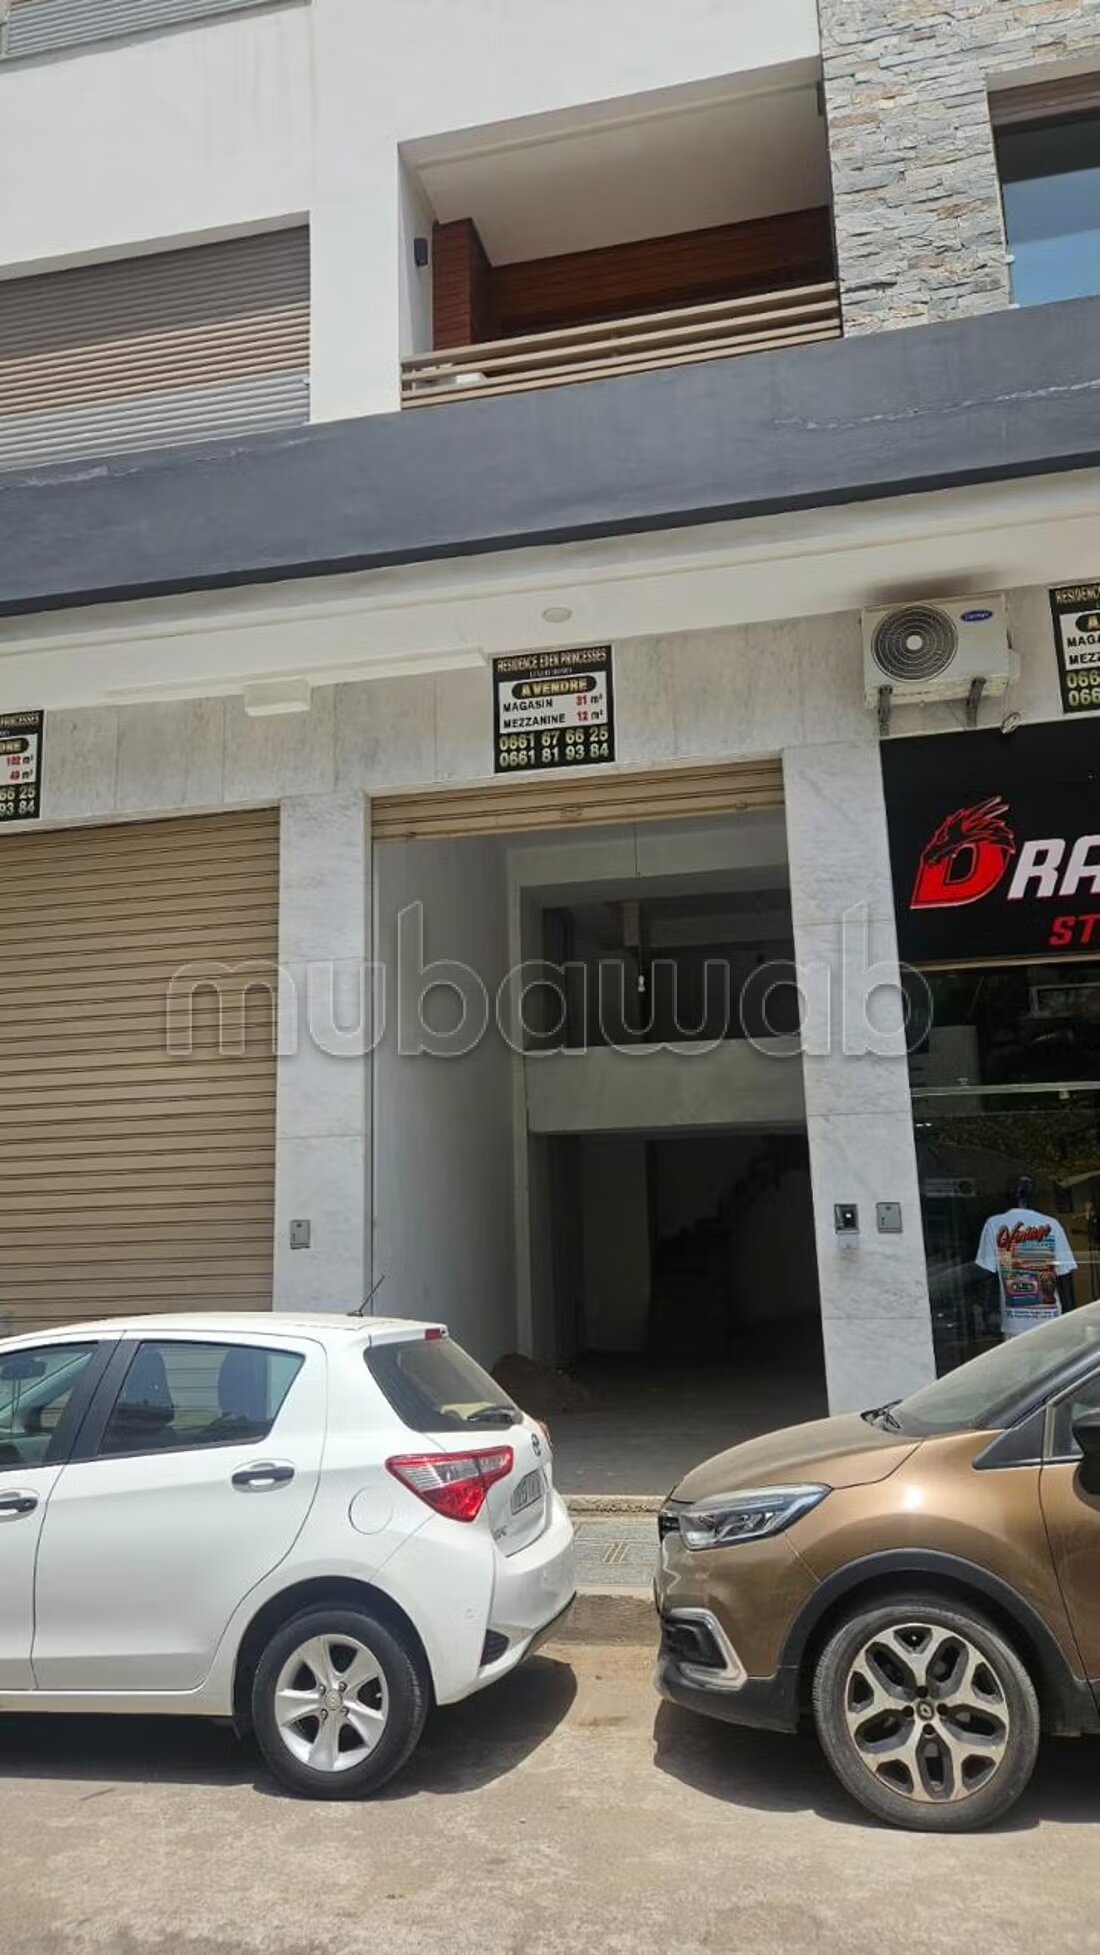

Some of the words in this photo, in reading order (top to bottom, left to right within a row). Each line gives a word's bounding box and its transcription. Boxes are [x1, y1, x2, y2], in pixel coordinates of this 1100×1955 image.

[1067, 633, 1100, 648] MAG
[532, 678, 588, 695] VENDRE
[503, 698, 553, 712] MAGASIN
[503, 713, 566, 728] MEZZANINE
[500, 733, 535, 751] 0661
[541, 730, 560, 747] 67
[565, 728, 585, 744] 66
[589, 726, 609, 741] 25
[500, 749, 536, 767] 0661
[541, 746, 560, 763] 81
[565, 744, 585, 760] 93
[590, 742, 609, 757] 84
[20, 784, 36, 799] 25
[19, 799, 35, 815] 84
